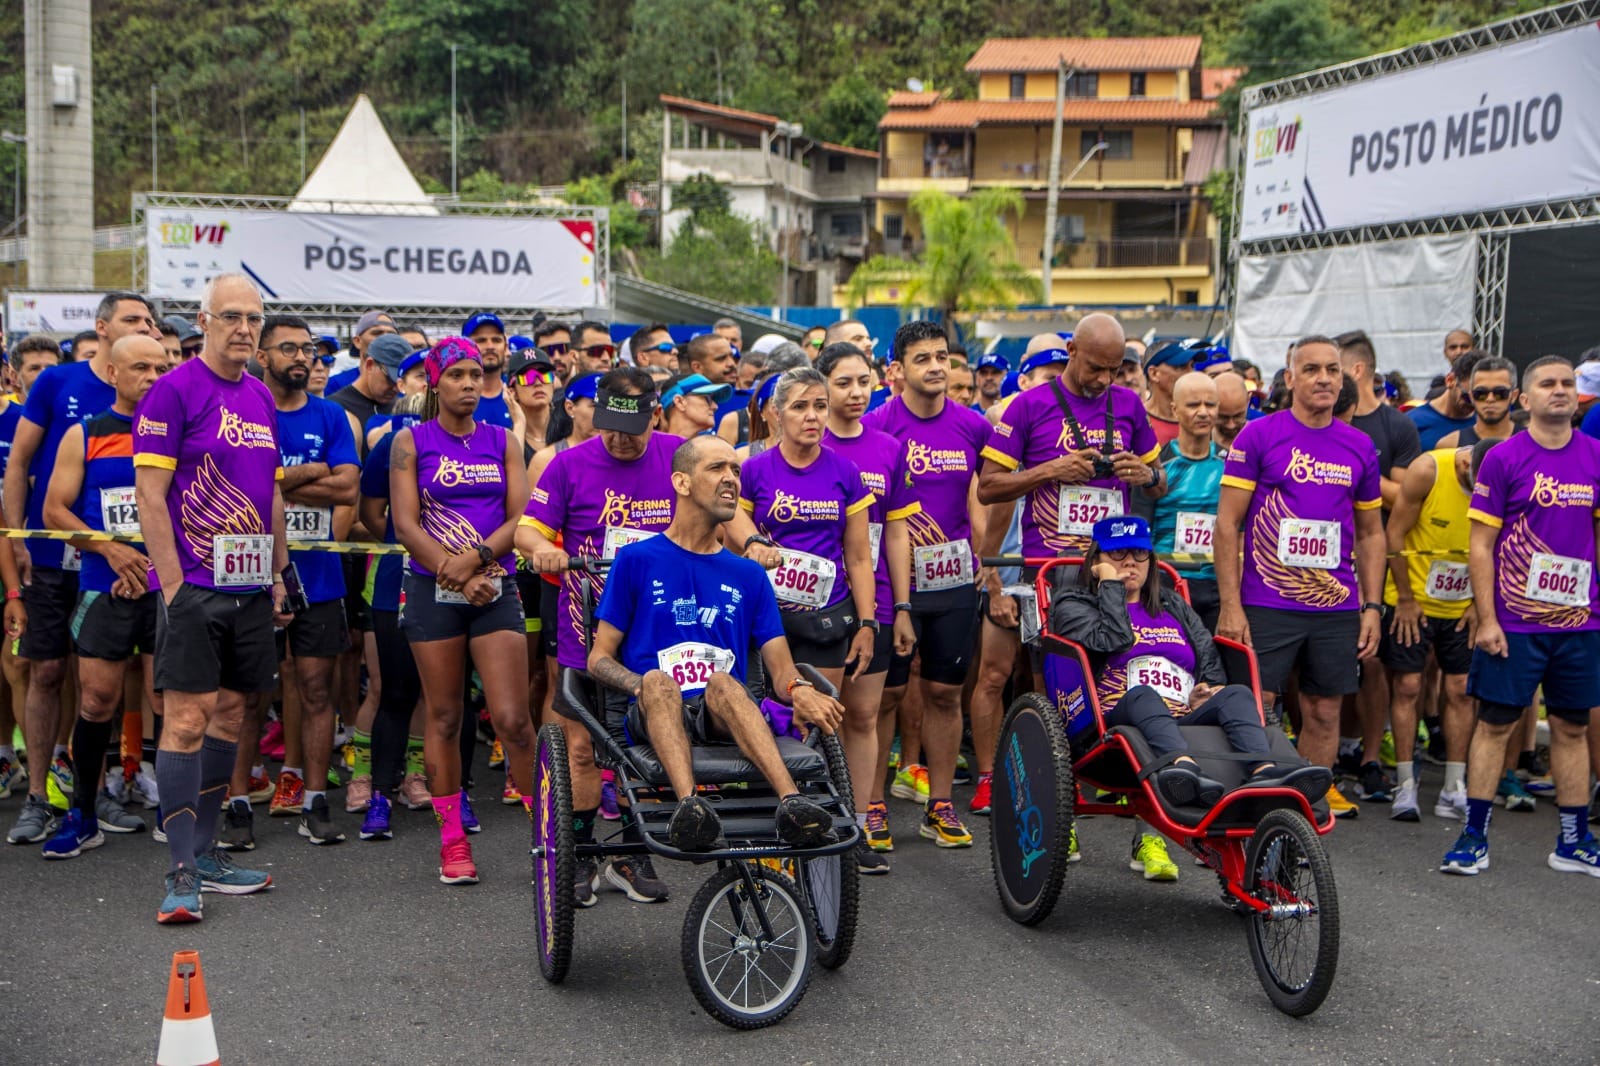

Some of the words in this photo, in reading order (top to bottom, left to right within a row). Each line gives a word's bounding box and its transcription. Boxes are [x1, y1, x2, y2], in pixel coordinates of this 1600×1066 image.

[1349, 120, 1436, 176] POSTO
[1443, 93, 1562, 160] MÉDICO
[305, 237, 532, 275] PÓS-CHEGADA
[524, 348, 537, 361] NY
[242, 422, 272, 435] PERNAS
[252, 440, 276, 450] SUZANO
[931, 450, 967, 460] PERNAS
[464, 464, 499, 473] PERNAS
[1315, 462, 1352, 474] PERNAS
[1315, 470, 1352, 481] SOLIDARIAS
[1324, 477, 1352, 487] SUZANO
[1558, 483, 1594, 494] PERNAS
[631, 499, 671, 511] PERNAS
[800, 500, 839, 509] PERNAS
[1568, 499, 1593, 507] SUZANO
[631, 509, 671, 518] SOLIDARIAS
[1068, 503, 1109, 524] 5327
[642, 516, 671, 525] SUZANO
[1288, 537, 1327, 557] 5906
[225, 553, 261, 574] 6171
[925, 558, 961, 580] 5443
[775, 566, 819, 594] 5902
[1538, 571, 1578, 595] 6002
[672, 661, 715, 687] 6321
[1139, 669, 1182, 692] 5356
[1067, 685, 1083, 705] PERNAS
[1560, 813, 1578, 844] RUN
